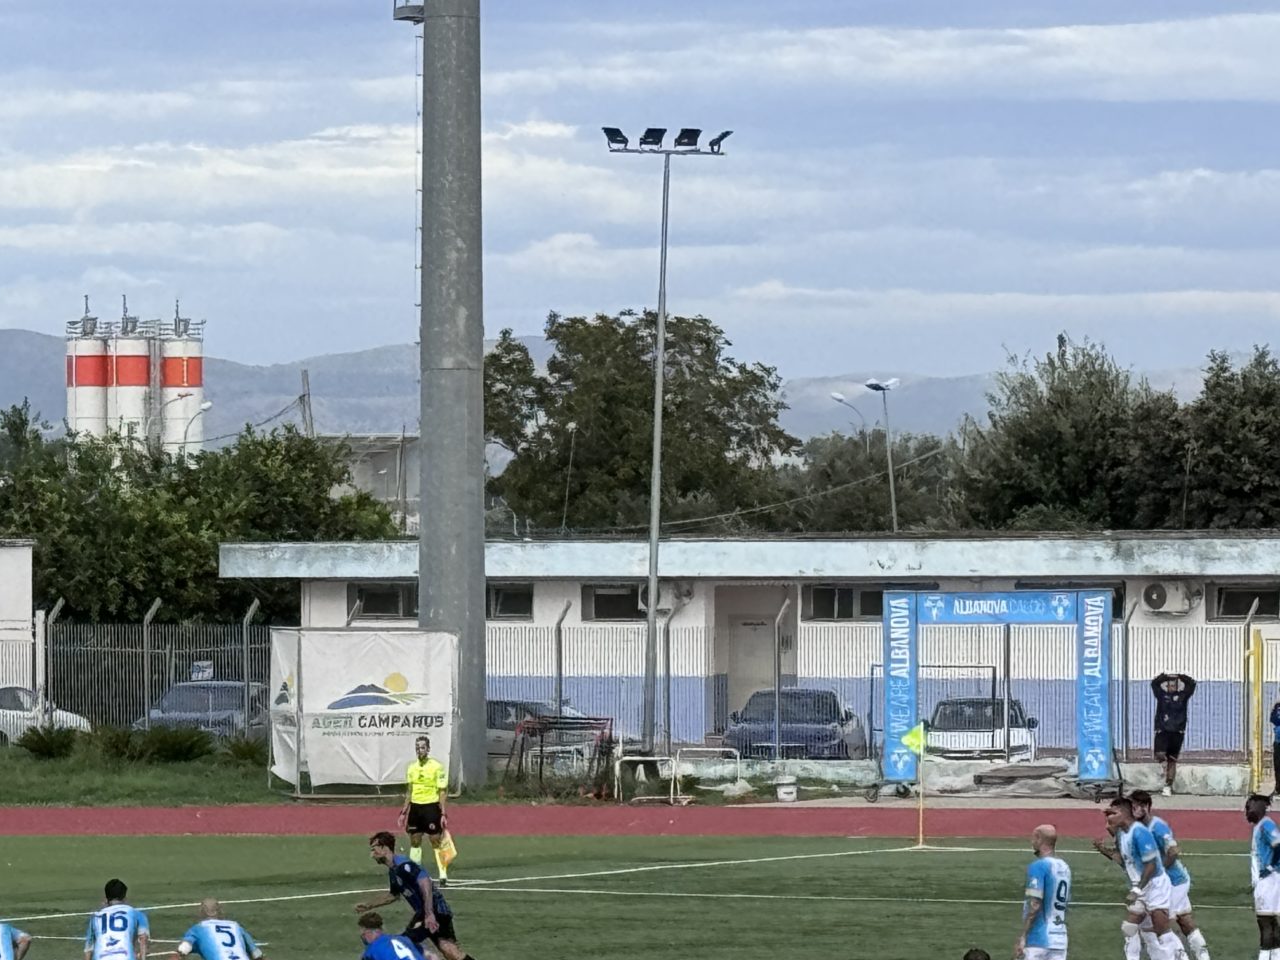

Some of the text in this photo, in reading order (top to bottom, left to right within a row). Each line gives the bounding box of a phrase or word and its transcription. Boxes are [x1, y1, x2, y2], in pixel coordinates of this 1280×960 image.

[1054, 879, 1068, 911] 9
[95, 911, 128, 935] 16
[215, 925, 236, 947] 5
